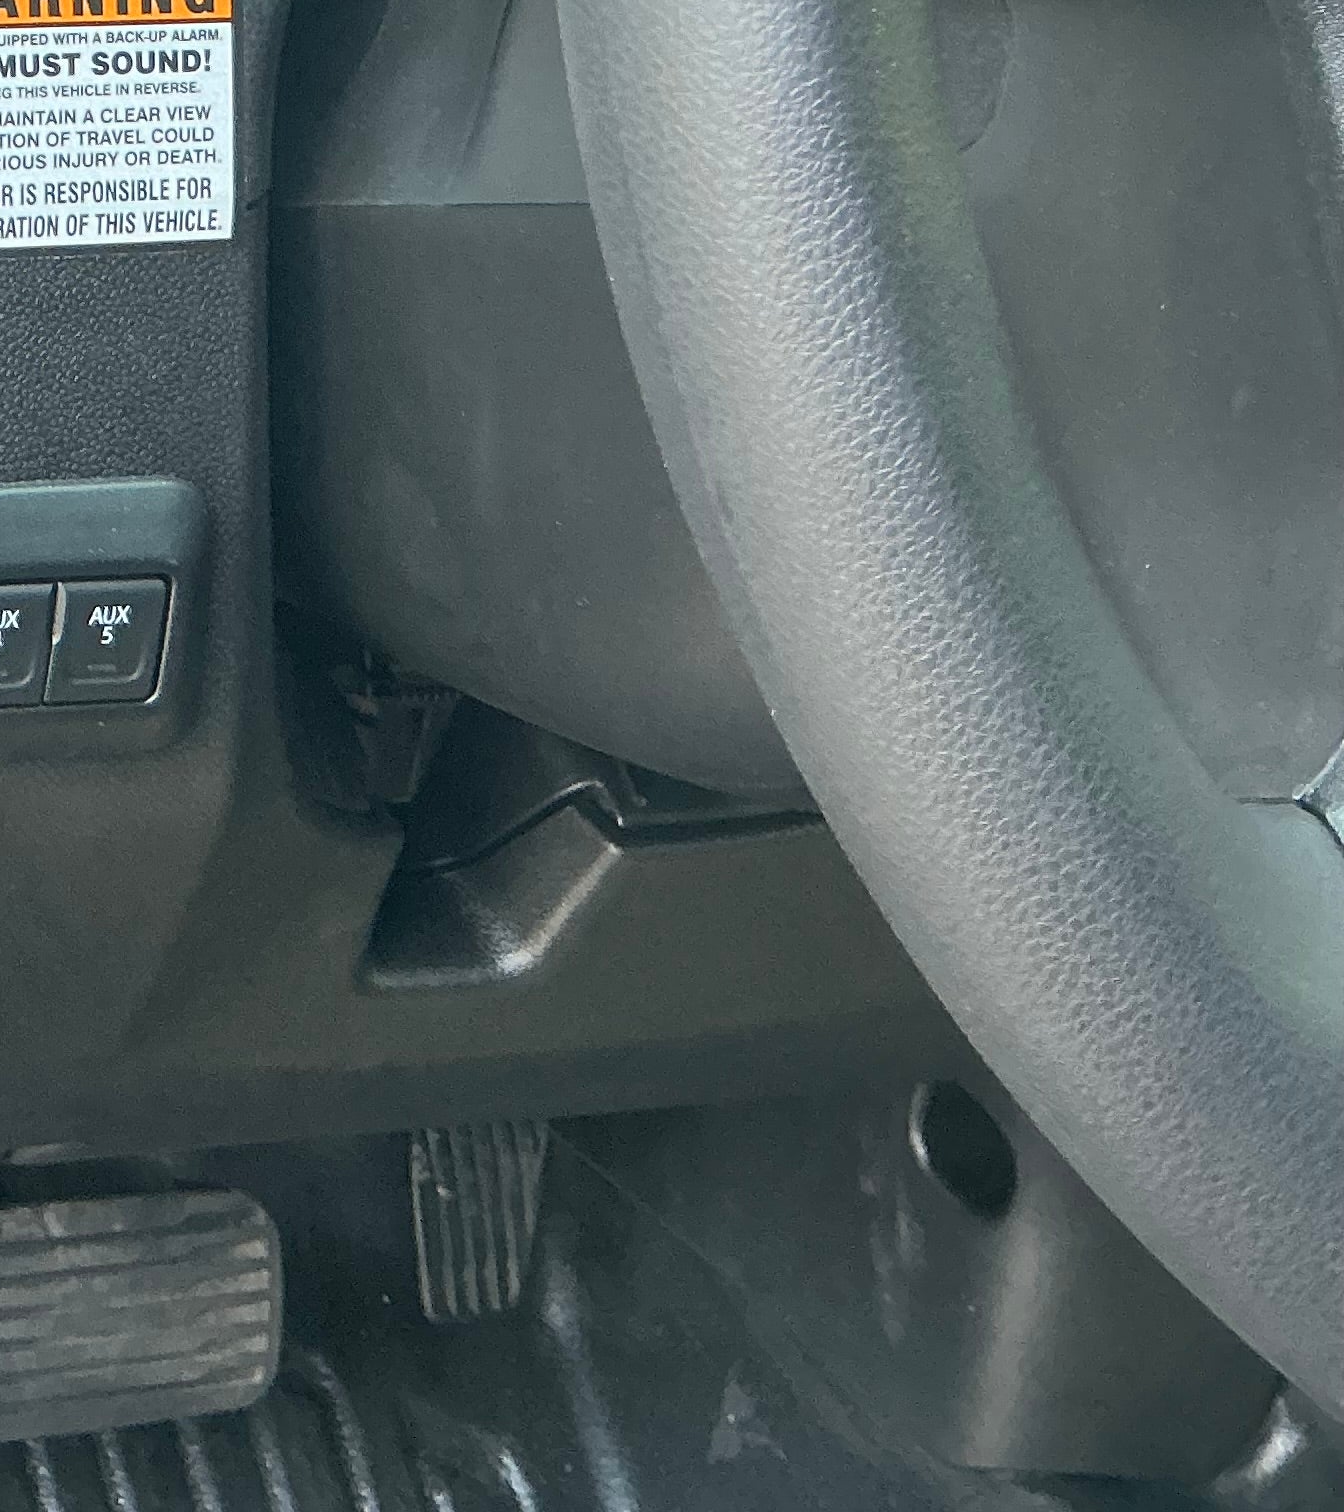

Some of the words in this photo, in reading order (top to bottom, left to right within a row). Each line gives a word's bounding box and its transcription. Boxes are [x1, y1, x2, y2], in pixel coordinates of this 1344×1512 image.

[53, 32, 88, 45] WITH
[92, 32, 102, 44] A
[106, 30, 168, 44] BACK-UP
[91, 48, 212, 76] SOUND!
[16, 86, 49, 98] THIS
[53, 84, 111, 97] VEHICLE
[116, 83, 130, 95] IN
[82, 109, 95, 124] A
[100, 107, 161, 124] CLEAR
[166, 105, 212, 121] VIEW
[46, 131, 70, 147] OF
[76, 129, 146, 146] TRAVEL
[151, 127, 215, 143] COULD
[53, 152, 119, 169] INJURY
[124, 151, 151, 166] OR
[20, 183, 37, 206] IS
[44, 179, 170, 204] RESPONSIBLE
[176, 177, 212, 200] FOR
[65, 213, 90, 236] OF
[94, 212, 136, 235] THIS
[88, 606, 131, 627] AUX
[100, 625, 113, 645] 5
